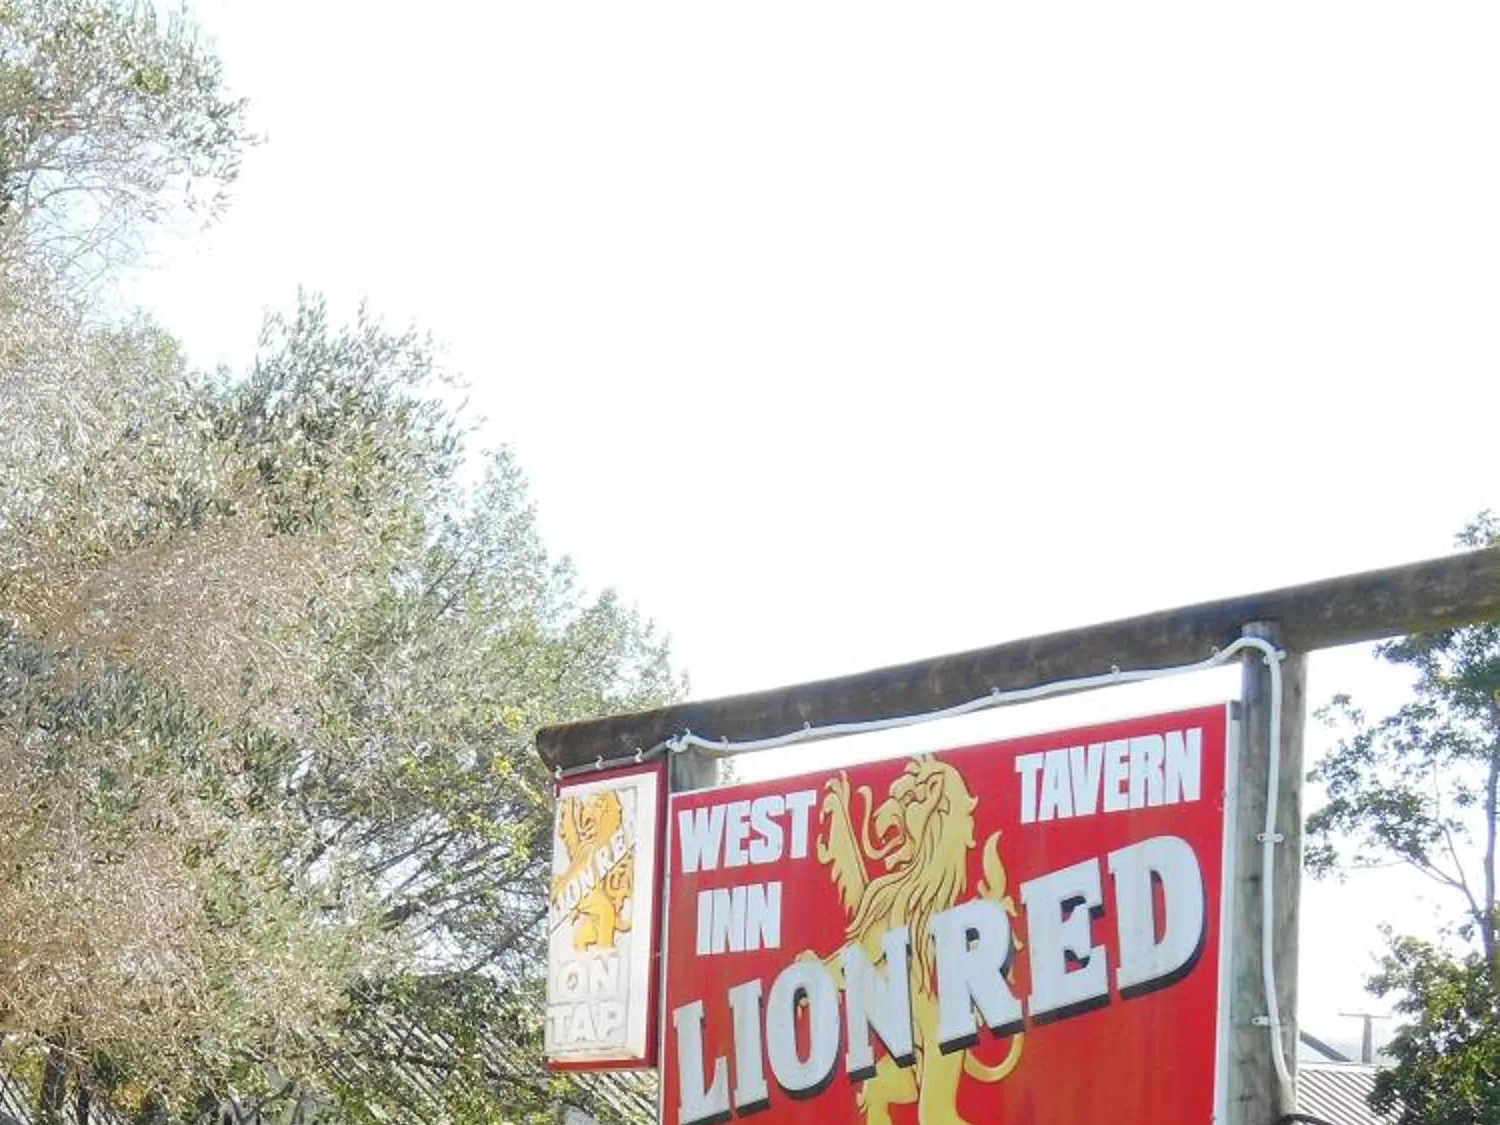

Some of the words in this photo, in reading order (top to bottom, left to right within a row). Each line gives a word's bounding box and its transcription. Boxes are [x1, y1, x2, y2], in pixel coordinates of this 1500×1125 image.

[1016, 729, 1202, 823] TAVERN
[680, 791, 816, 873] WEST
[697, 882, 781, 955] INN
[934, 835, 1206, 1054] RED
[555, 959, 622, 999] ON
[548, 1003, 625, 1043] TAP
